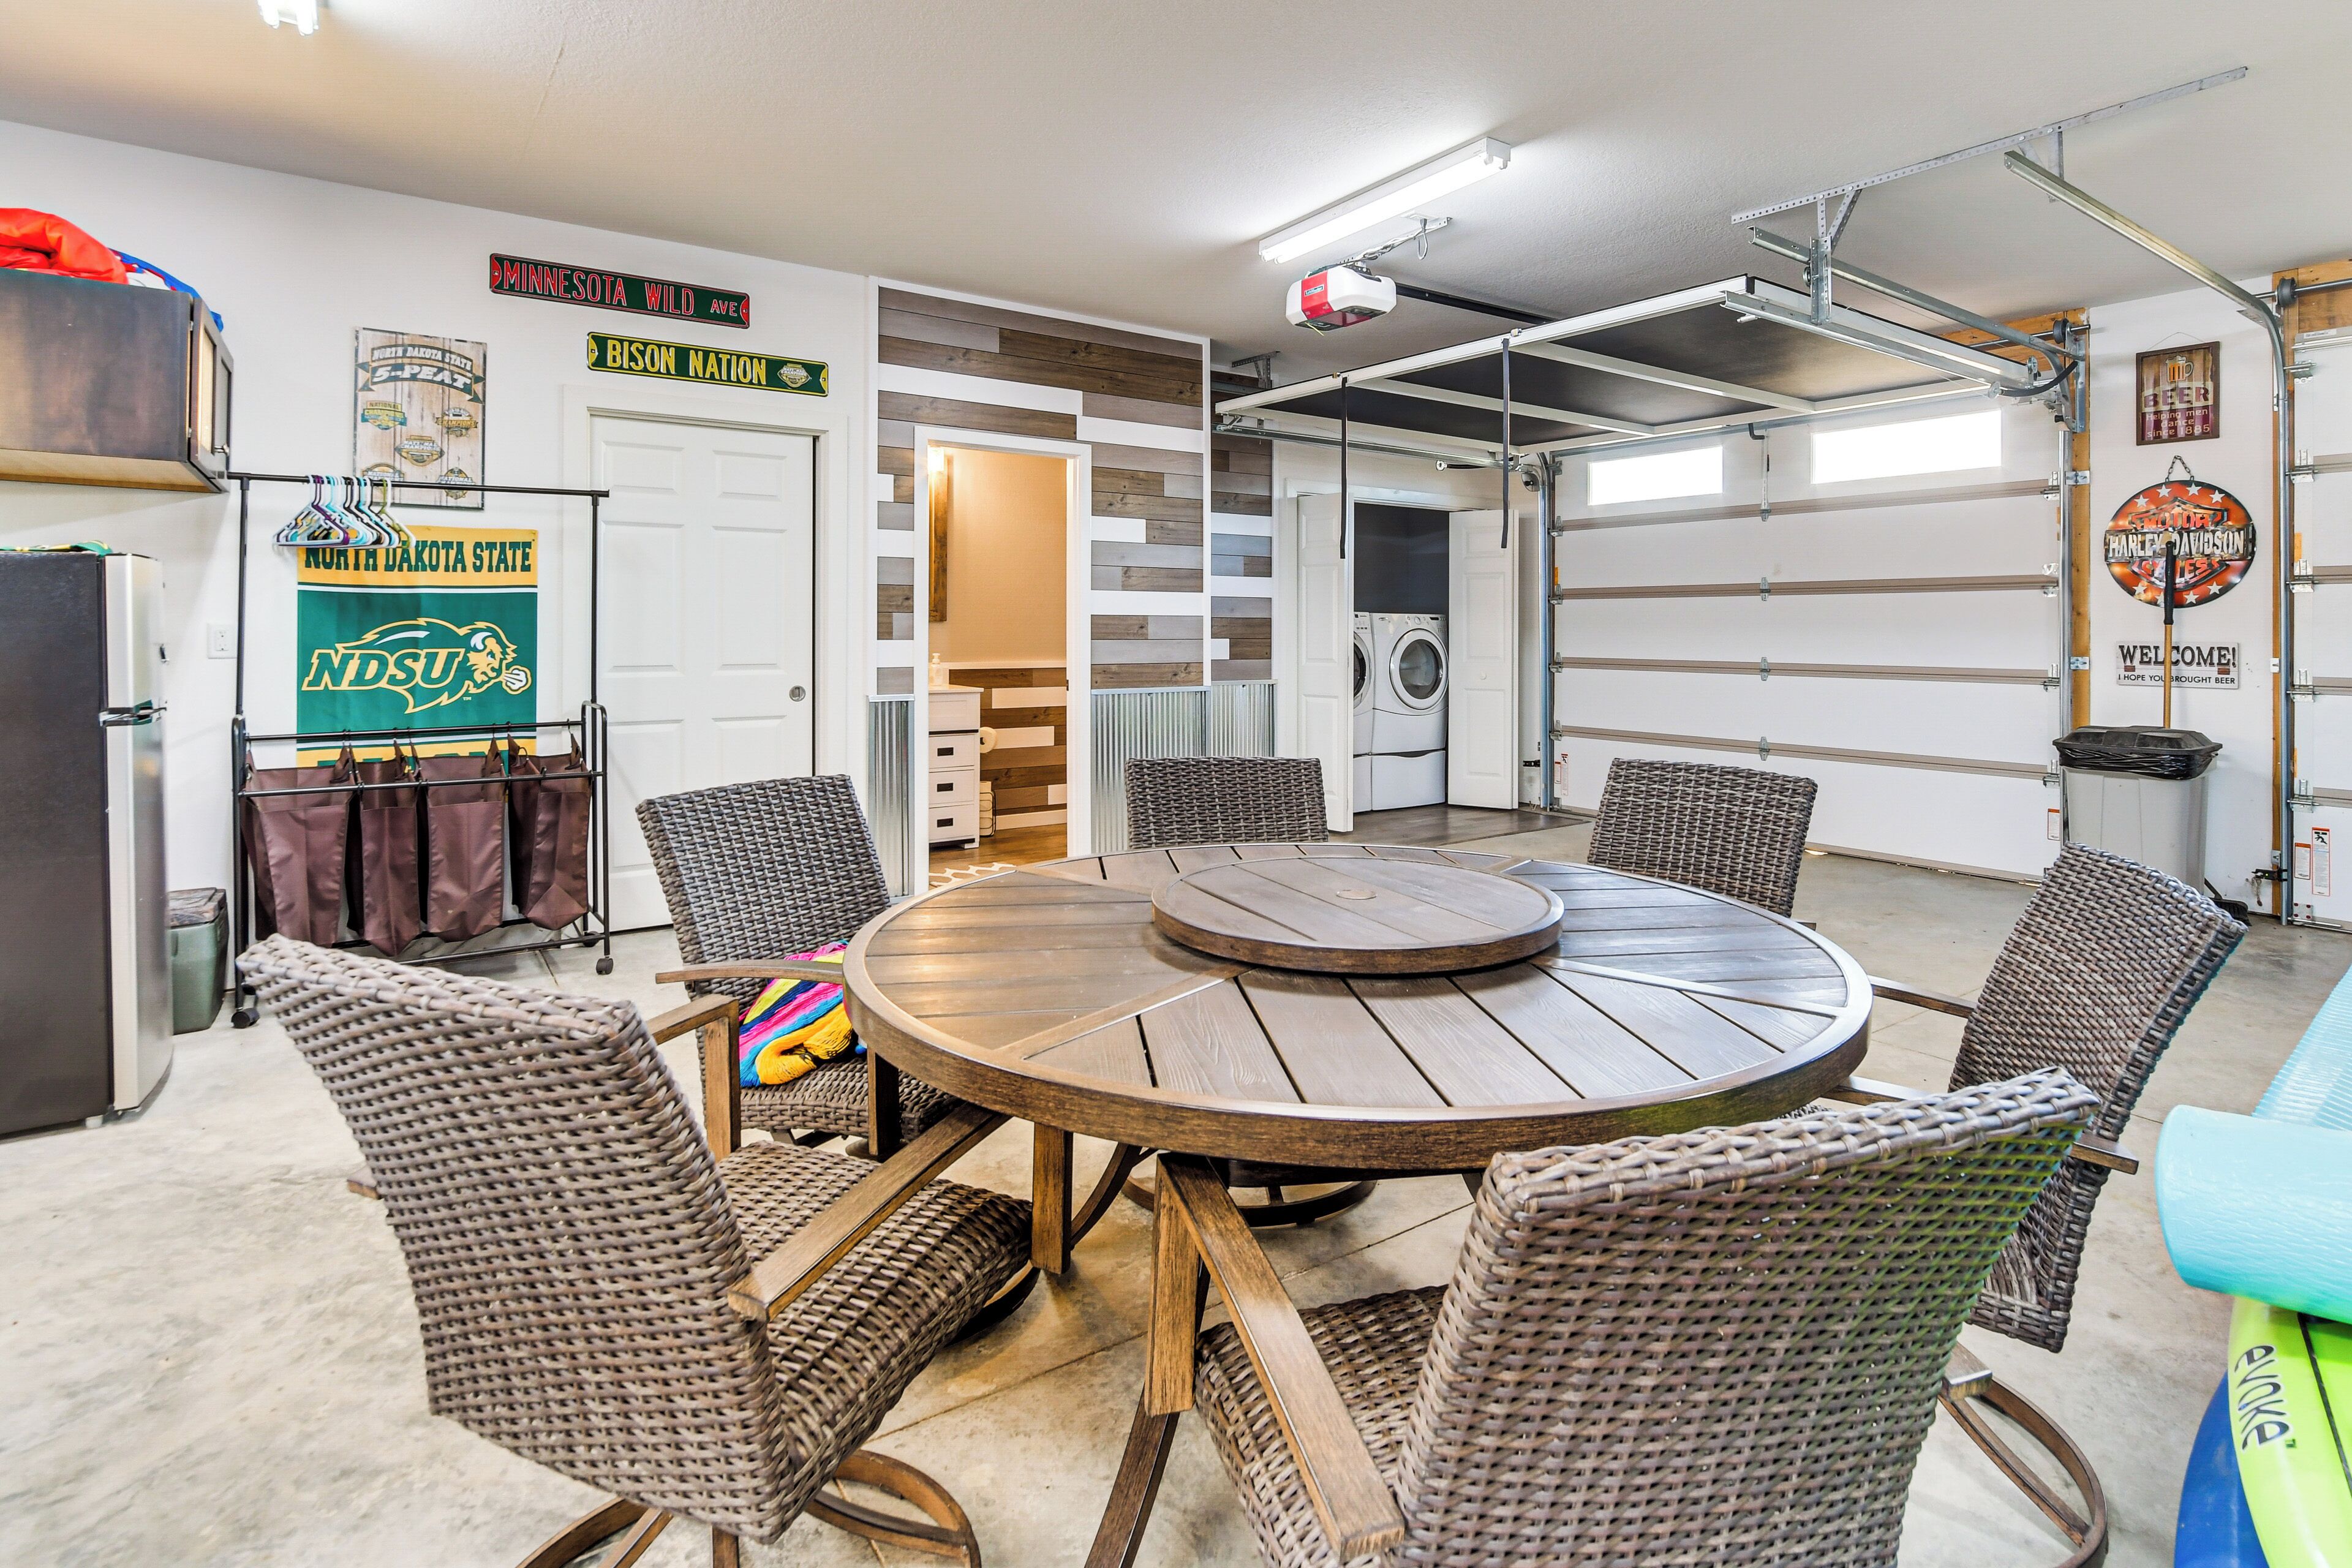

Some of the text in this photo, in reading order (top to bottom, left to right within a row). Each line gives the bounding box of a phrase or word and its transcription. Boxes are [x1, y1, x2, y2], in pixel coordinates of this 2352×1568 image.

[503, 260, 738, 317] MINNESOTA WILD AVE
[372, 346, 472, 371] NORTH DAKOTA STATE
[606, 339, 767, 385] BISON NATION
[372, 364, 472, 389] 5-PEAT
[2144, 386, 2210, 409] BEER
[2146, 411, 2181, 421] Helping
[2160, 418, 2195, 428] dance
[2146, 424, 2211, 437] since 1885
[384, 541, 467, 572] DAKOTA
[472, 541, 532, 573] STATE
[2142, 557, 2208, 577] CYLES
[2119, 645, 2237, 668] WELCOME!
[302, 648, 466, 691] NDSU
[2234, 1344, 2290, 1450] evoke
